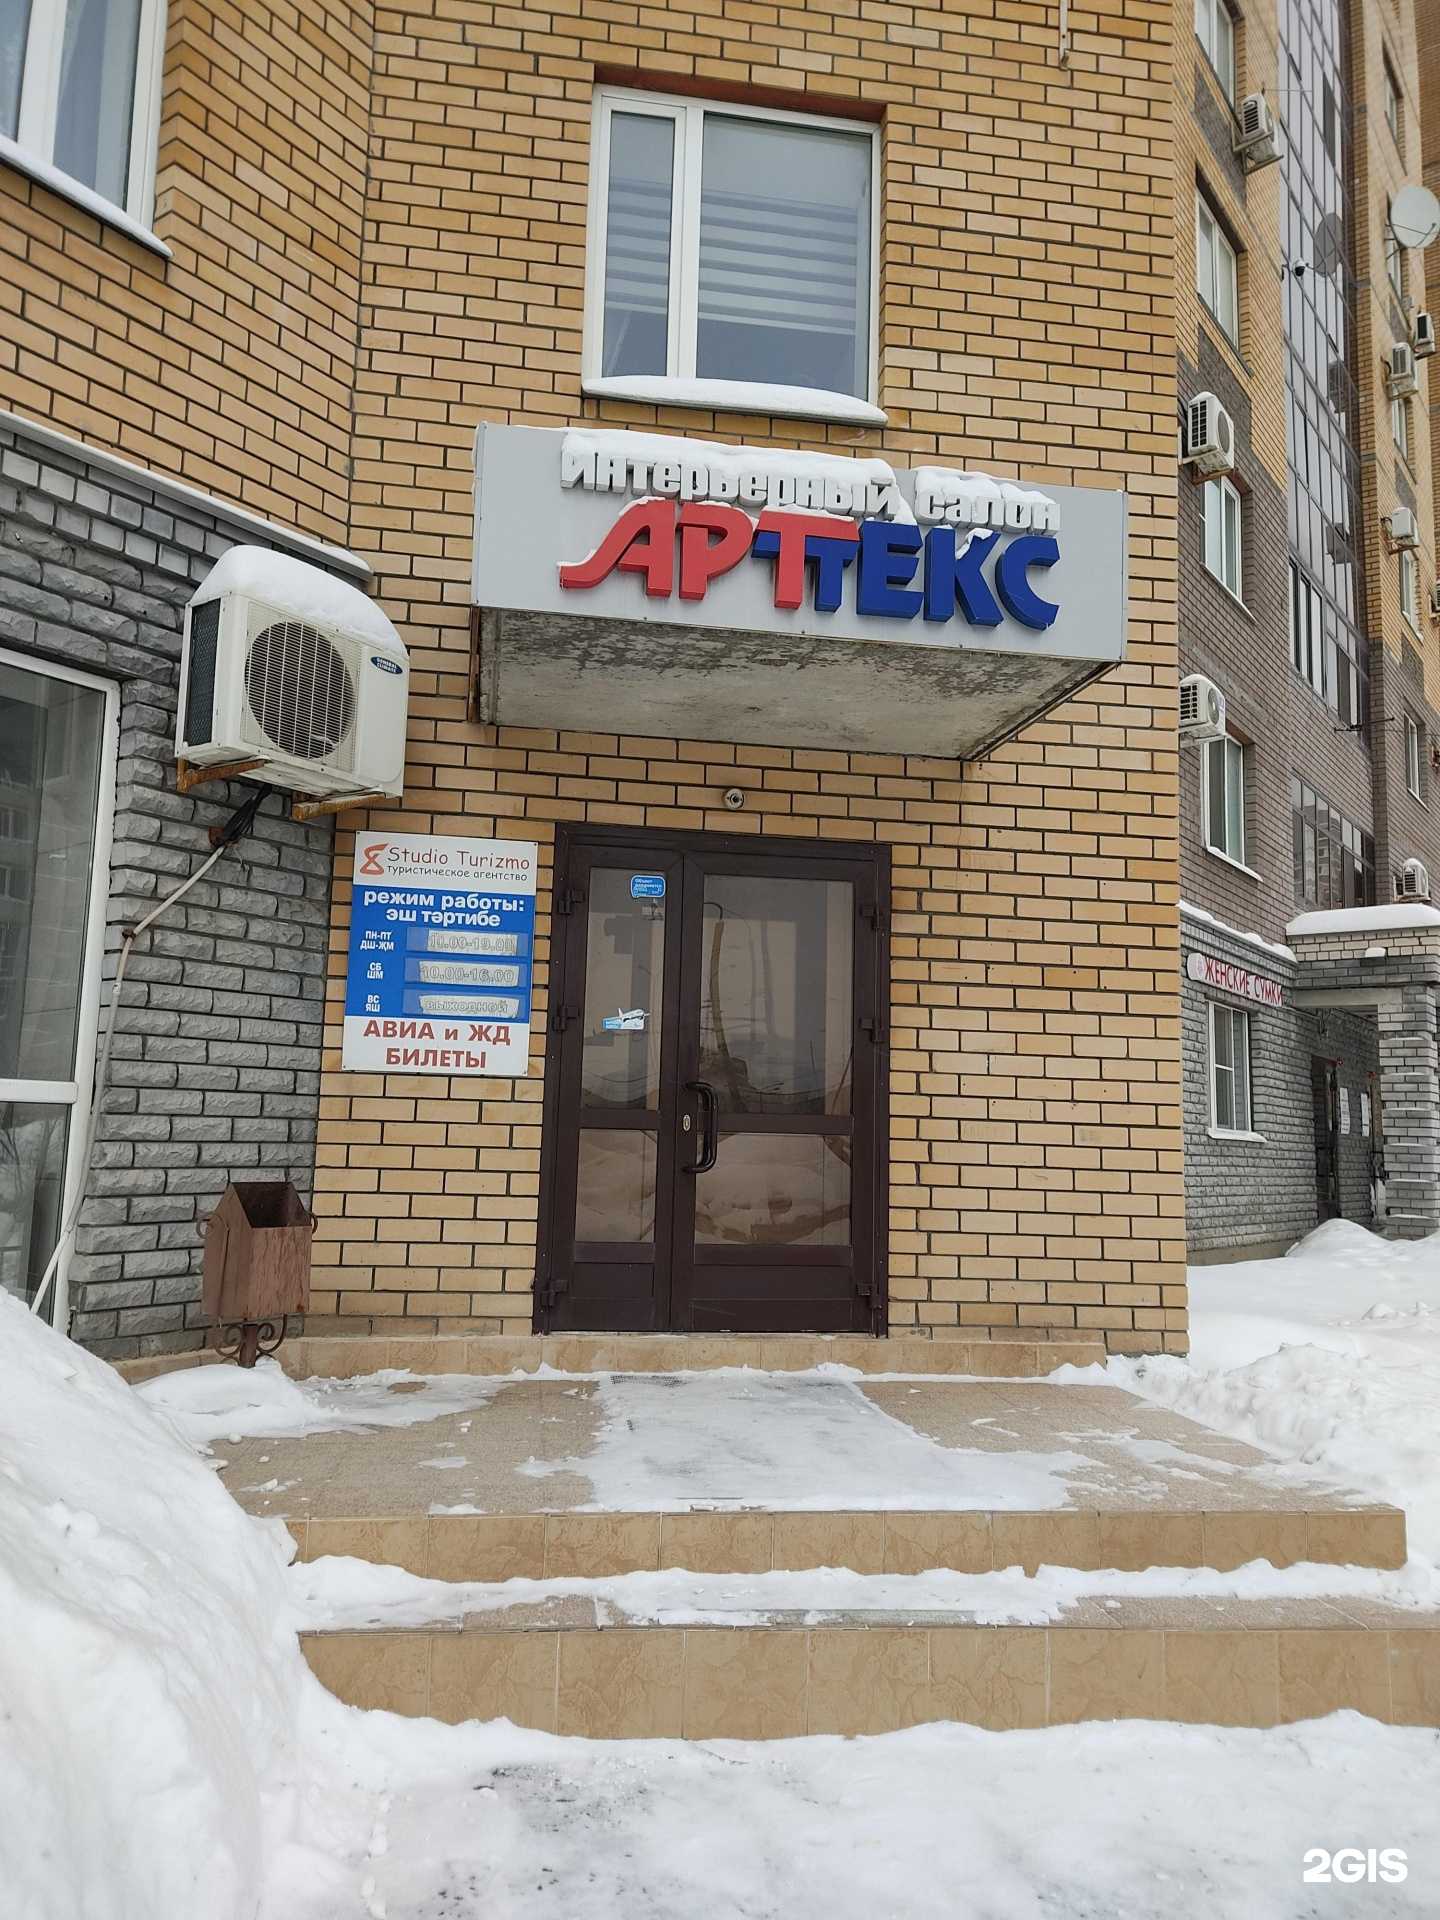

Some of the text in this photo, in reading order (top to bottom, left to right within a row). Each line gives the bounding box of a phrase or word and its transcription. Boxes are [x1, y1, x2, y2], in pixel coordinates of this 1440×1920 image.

[915, 486, 1061, 535] салон
[386, 846, 531, 871] Studio Turizmo
[386, 864, 528, 882] туристическое агентство
[363, 890, 525, 912] режим работы:
[385, 908, 502, 927] эш тәртибе
[365, 930, 392, 941] ПН-ПТ
[366, 970, 384, 980] ШМ
[369, 962, 382, 971] СБ
[1205, 957, 1284, 1006] ЖЕНСКИЕ СУМКИ
[365, 1003, 381, 1013] ЯШ
[367, 994, 380, 1004] ВС
[363, 1019, 511, 1046] АВИА и ЖД
[385, 1047, 487, 1069] БИЛЕТЫ
